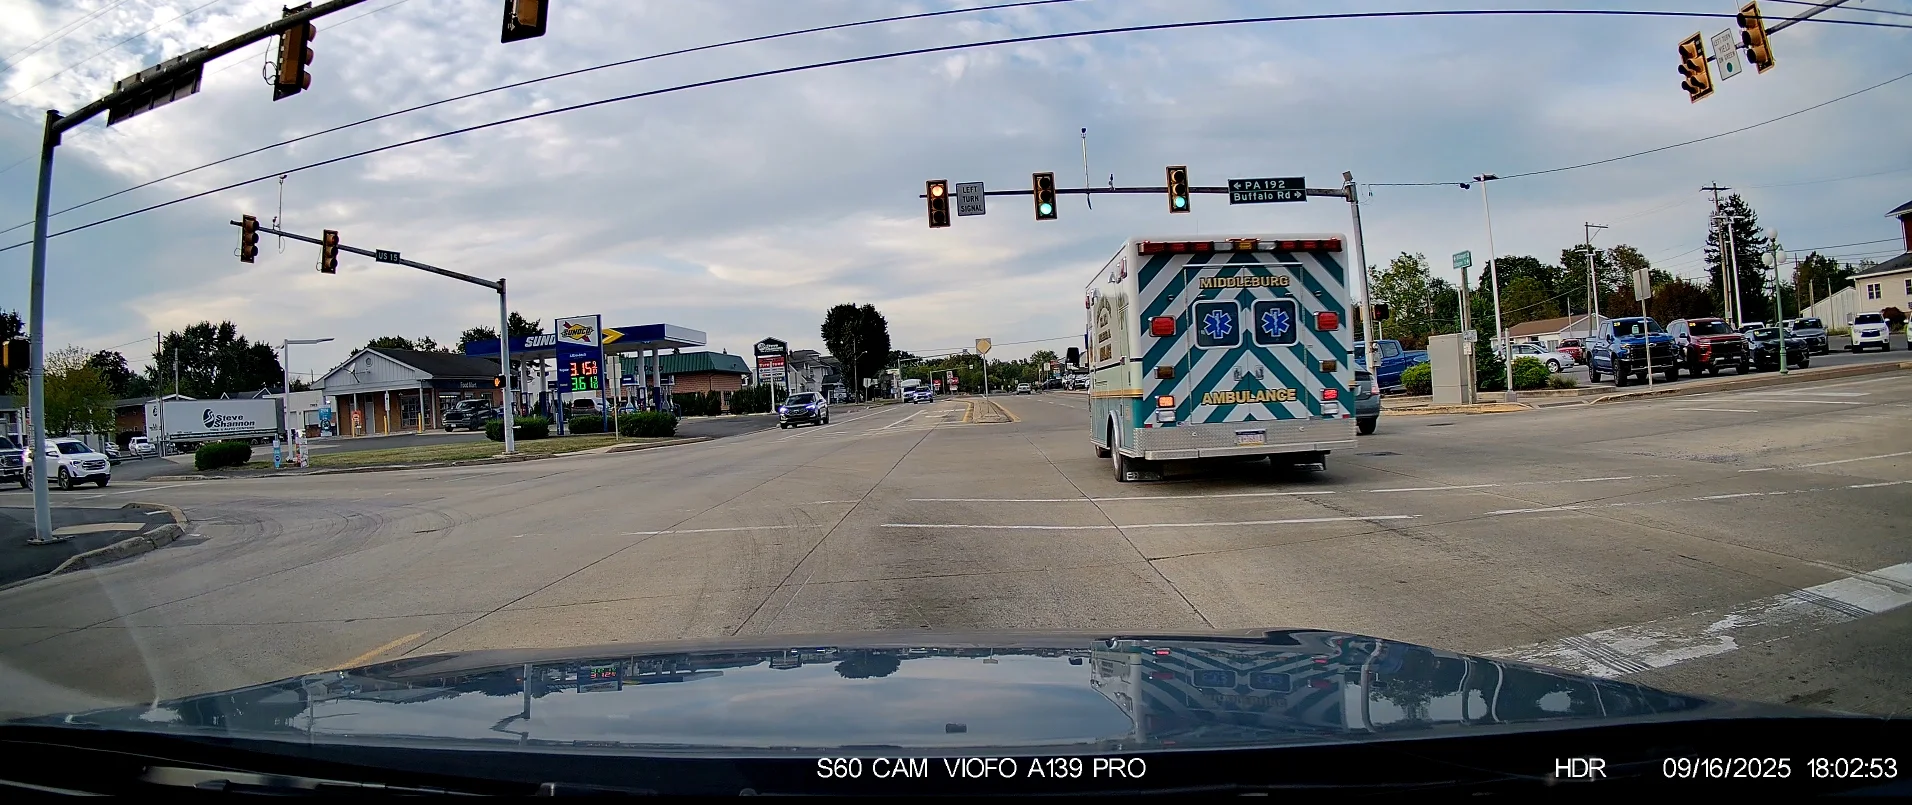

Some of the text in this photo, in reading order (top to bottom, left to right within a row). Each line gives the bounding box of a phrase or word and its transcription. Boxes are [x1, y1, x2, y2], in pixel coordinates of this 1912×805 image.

[1719, 43, 1731, 52] YIELD
[1724, 51, 1735, 61] GREEN
[1245, 180, 1286, 190] PA 192
[962, 186, 978, 194] LEFT
[962, 195, 980, 203] TURN
[1233, 190, 1291, 201] Buffalo Rd
[960, 204, 984, 213] SIGNAL
[379, 252, 388, 260] US
[1200, 276, 1289, 289] MIDDLEBURG
[561, 325, 594, 339] SUNOCO
[1202, 388, 1296, 405] AMBULANCE
[214, 420, 255, 428] Shannon
